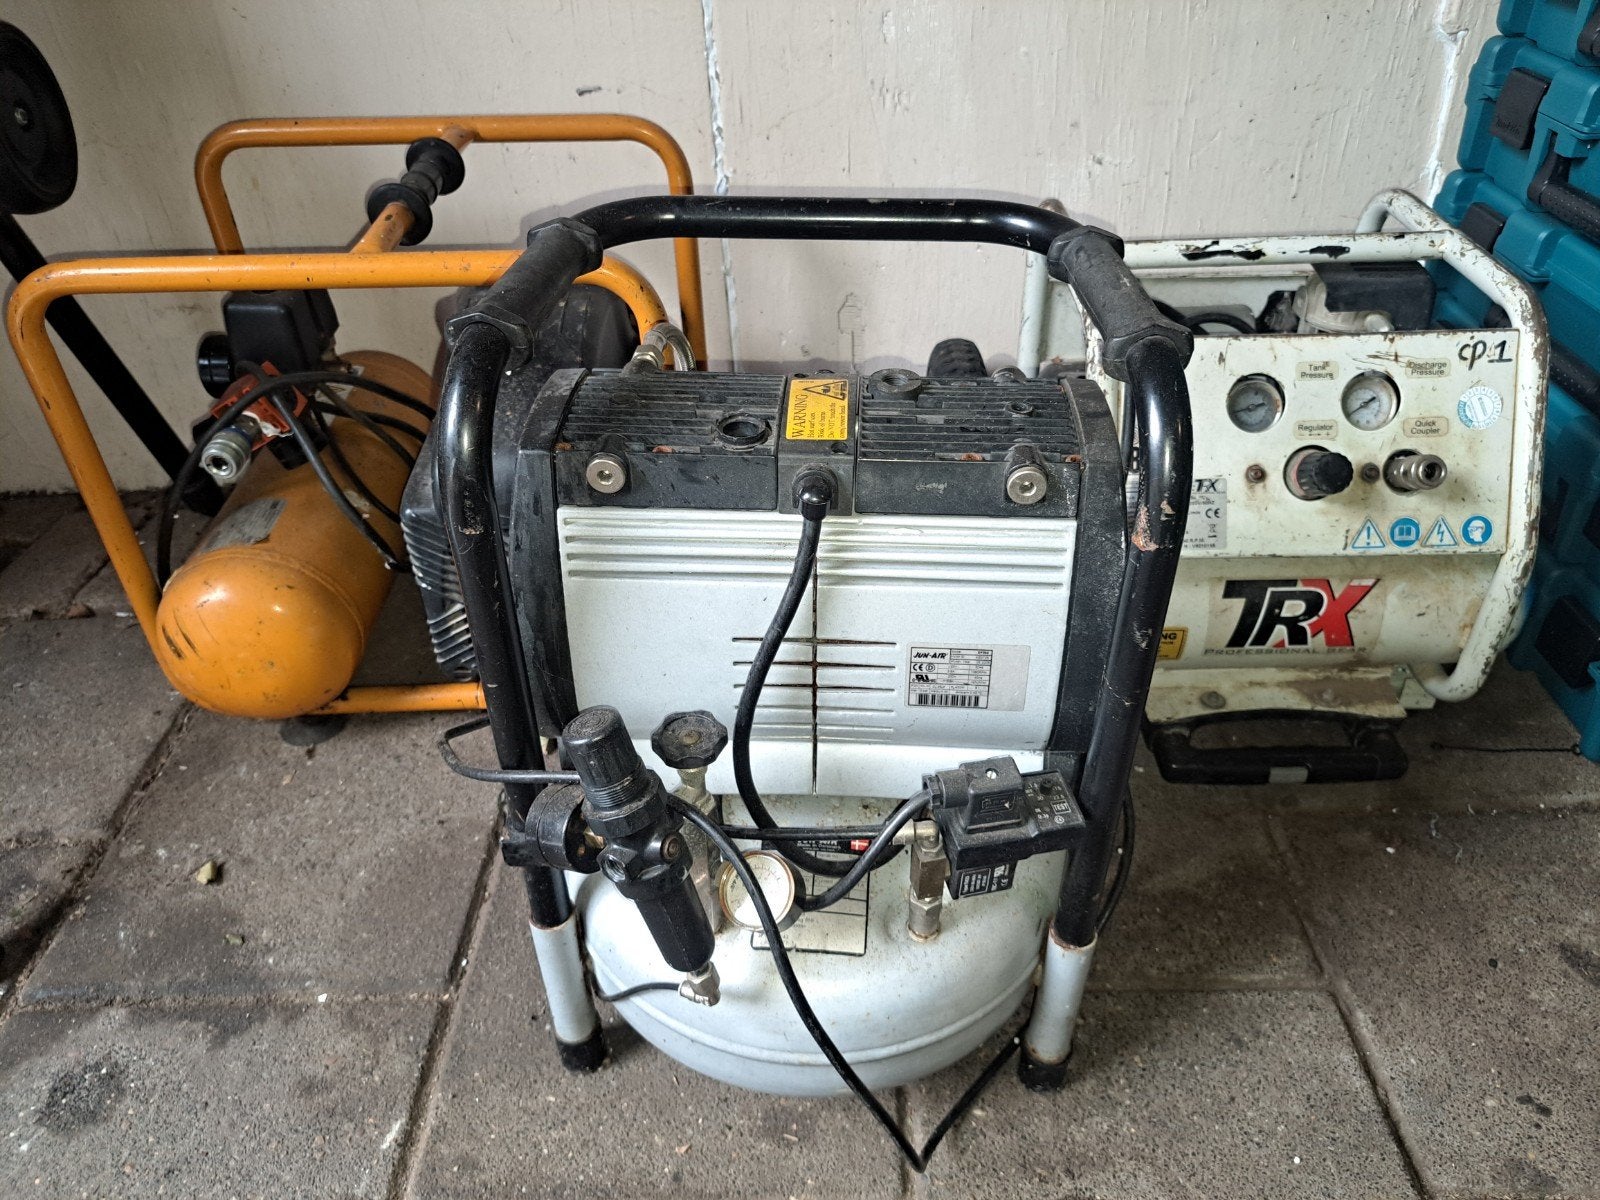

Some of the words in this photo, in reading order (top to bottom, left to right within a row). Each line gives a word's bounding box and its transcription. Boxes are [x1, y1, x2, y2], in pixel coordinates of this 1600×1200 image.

[1308, 363, 1327, 371] Tank
[1408, 361, 1448, 370] Discharge
[1300, 371, 1334, 380] Pressure
[792, 394, 808, 438] WARNING
[1298, 424, 1333, 432] Regulator
[1222, 578, 1381, 648] TRX
[913, 651, 947, 660] JUN-AIR
[1053, 803, 1069, 811] TEST
